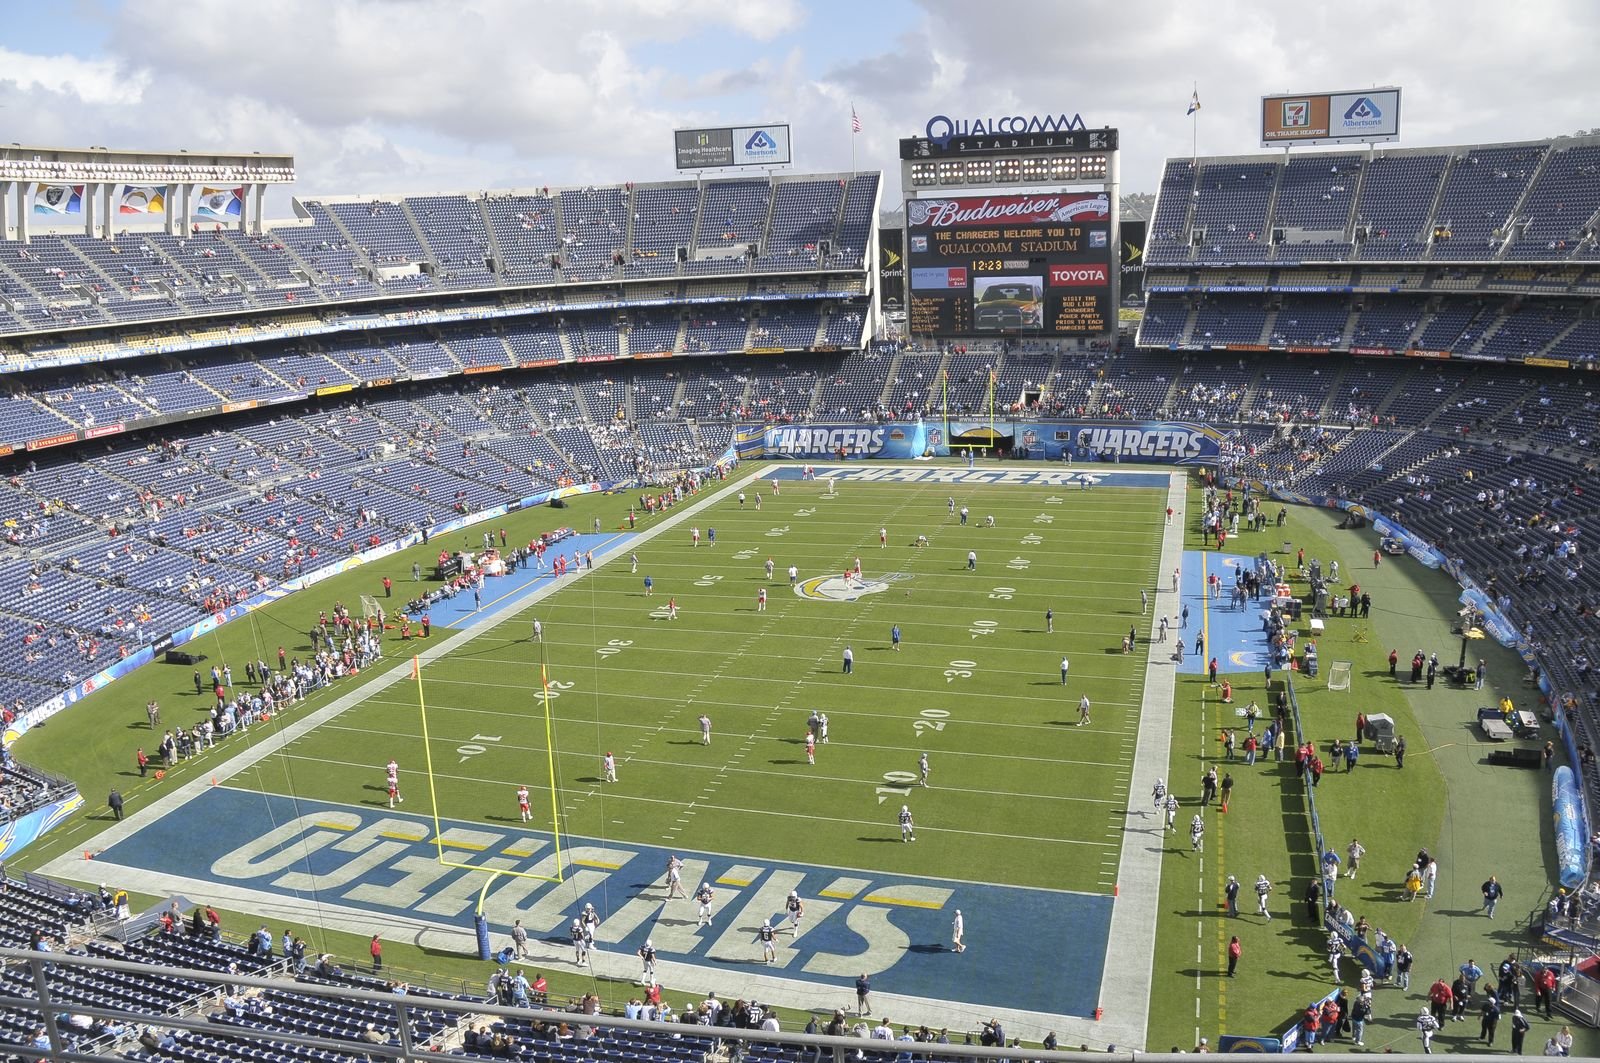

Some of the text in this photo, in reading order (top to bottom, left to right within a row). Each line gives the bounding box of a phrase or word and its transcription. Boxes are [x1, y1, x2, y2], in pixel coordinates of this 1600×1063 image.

[1342, 119, 1382, 127] Albertsons
[926, 113, 1086, 149] QUALCOMM
[960, 137, 1074, 149] STADIUM
[925, 196, 1060, 227] Budweiser
[1061, 202, 1107, 217] American Lager
[935, 231, 951, 240] THE
[955, 230, 999, 240] CHARGERS
[1004, 228, 1042, 238] WELCOME
[1047, 228, 1065, 237] YOU
[1069, 228, 1081, 237] TO
[939, 240, 1077, 255] QUALCOMM STADIUM
[972, 260, 1002, 271] 12:23
[1121, 264, 1144, 274] Sprint
[881, 269, 902, 278] Sprint
[1052, 270, 1105, 281] TOYOTA
[767, 428, 885, 455] CHARGERS
[929, 434, 940, 443] NFL
[1023, 435, 1036, 444] NFL
[1077, 428, 1206, 458] CHARGERS
[813, 467, 1111, 486] CHARGERS
[1020, 534, 1044, 545] 30
[1006, 558, 1032, 570] 40
[693, 574, 724, 586] 50
[988, 587, 1016, 600] 50
[968, 620, 999, 635] 40
[596, 638, 634, 655] 30
[943, 659, 977, 678] 30
[533, 680, 575, 700] 20
[912, 708, 951, 731] 20
[456, 733, 503, 756] 10
[875, 770, 918, 797] 10
[210, 810, 640, 934] DIEGO
[592, 857, 957, 979] SAN
[1324, 912, 1352, 941] CHARGERS
[763, 932, 769, 940] 6
[750, 1013, 759, 1023] 21
